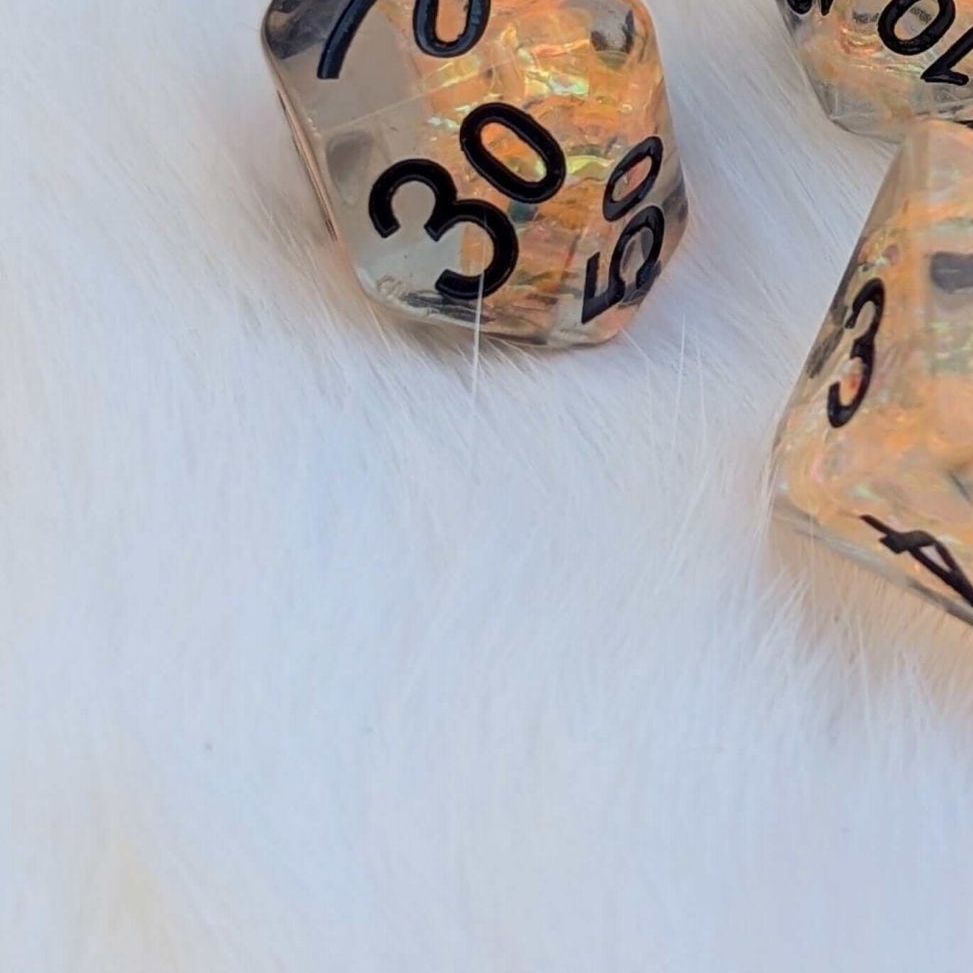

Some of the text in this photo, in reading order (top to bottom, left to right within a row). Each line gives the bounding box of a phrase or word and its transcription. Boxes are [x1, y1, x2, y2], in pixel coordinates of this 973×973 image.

[368, 101, 567, 300] 30
[581, 136, 665, 325] 50
[826, 278, 885, 428] 3
